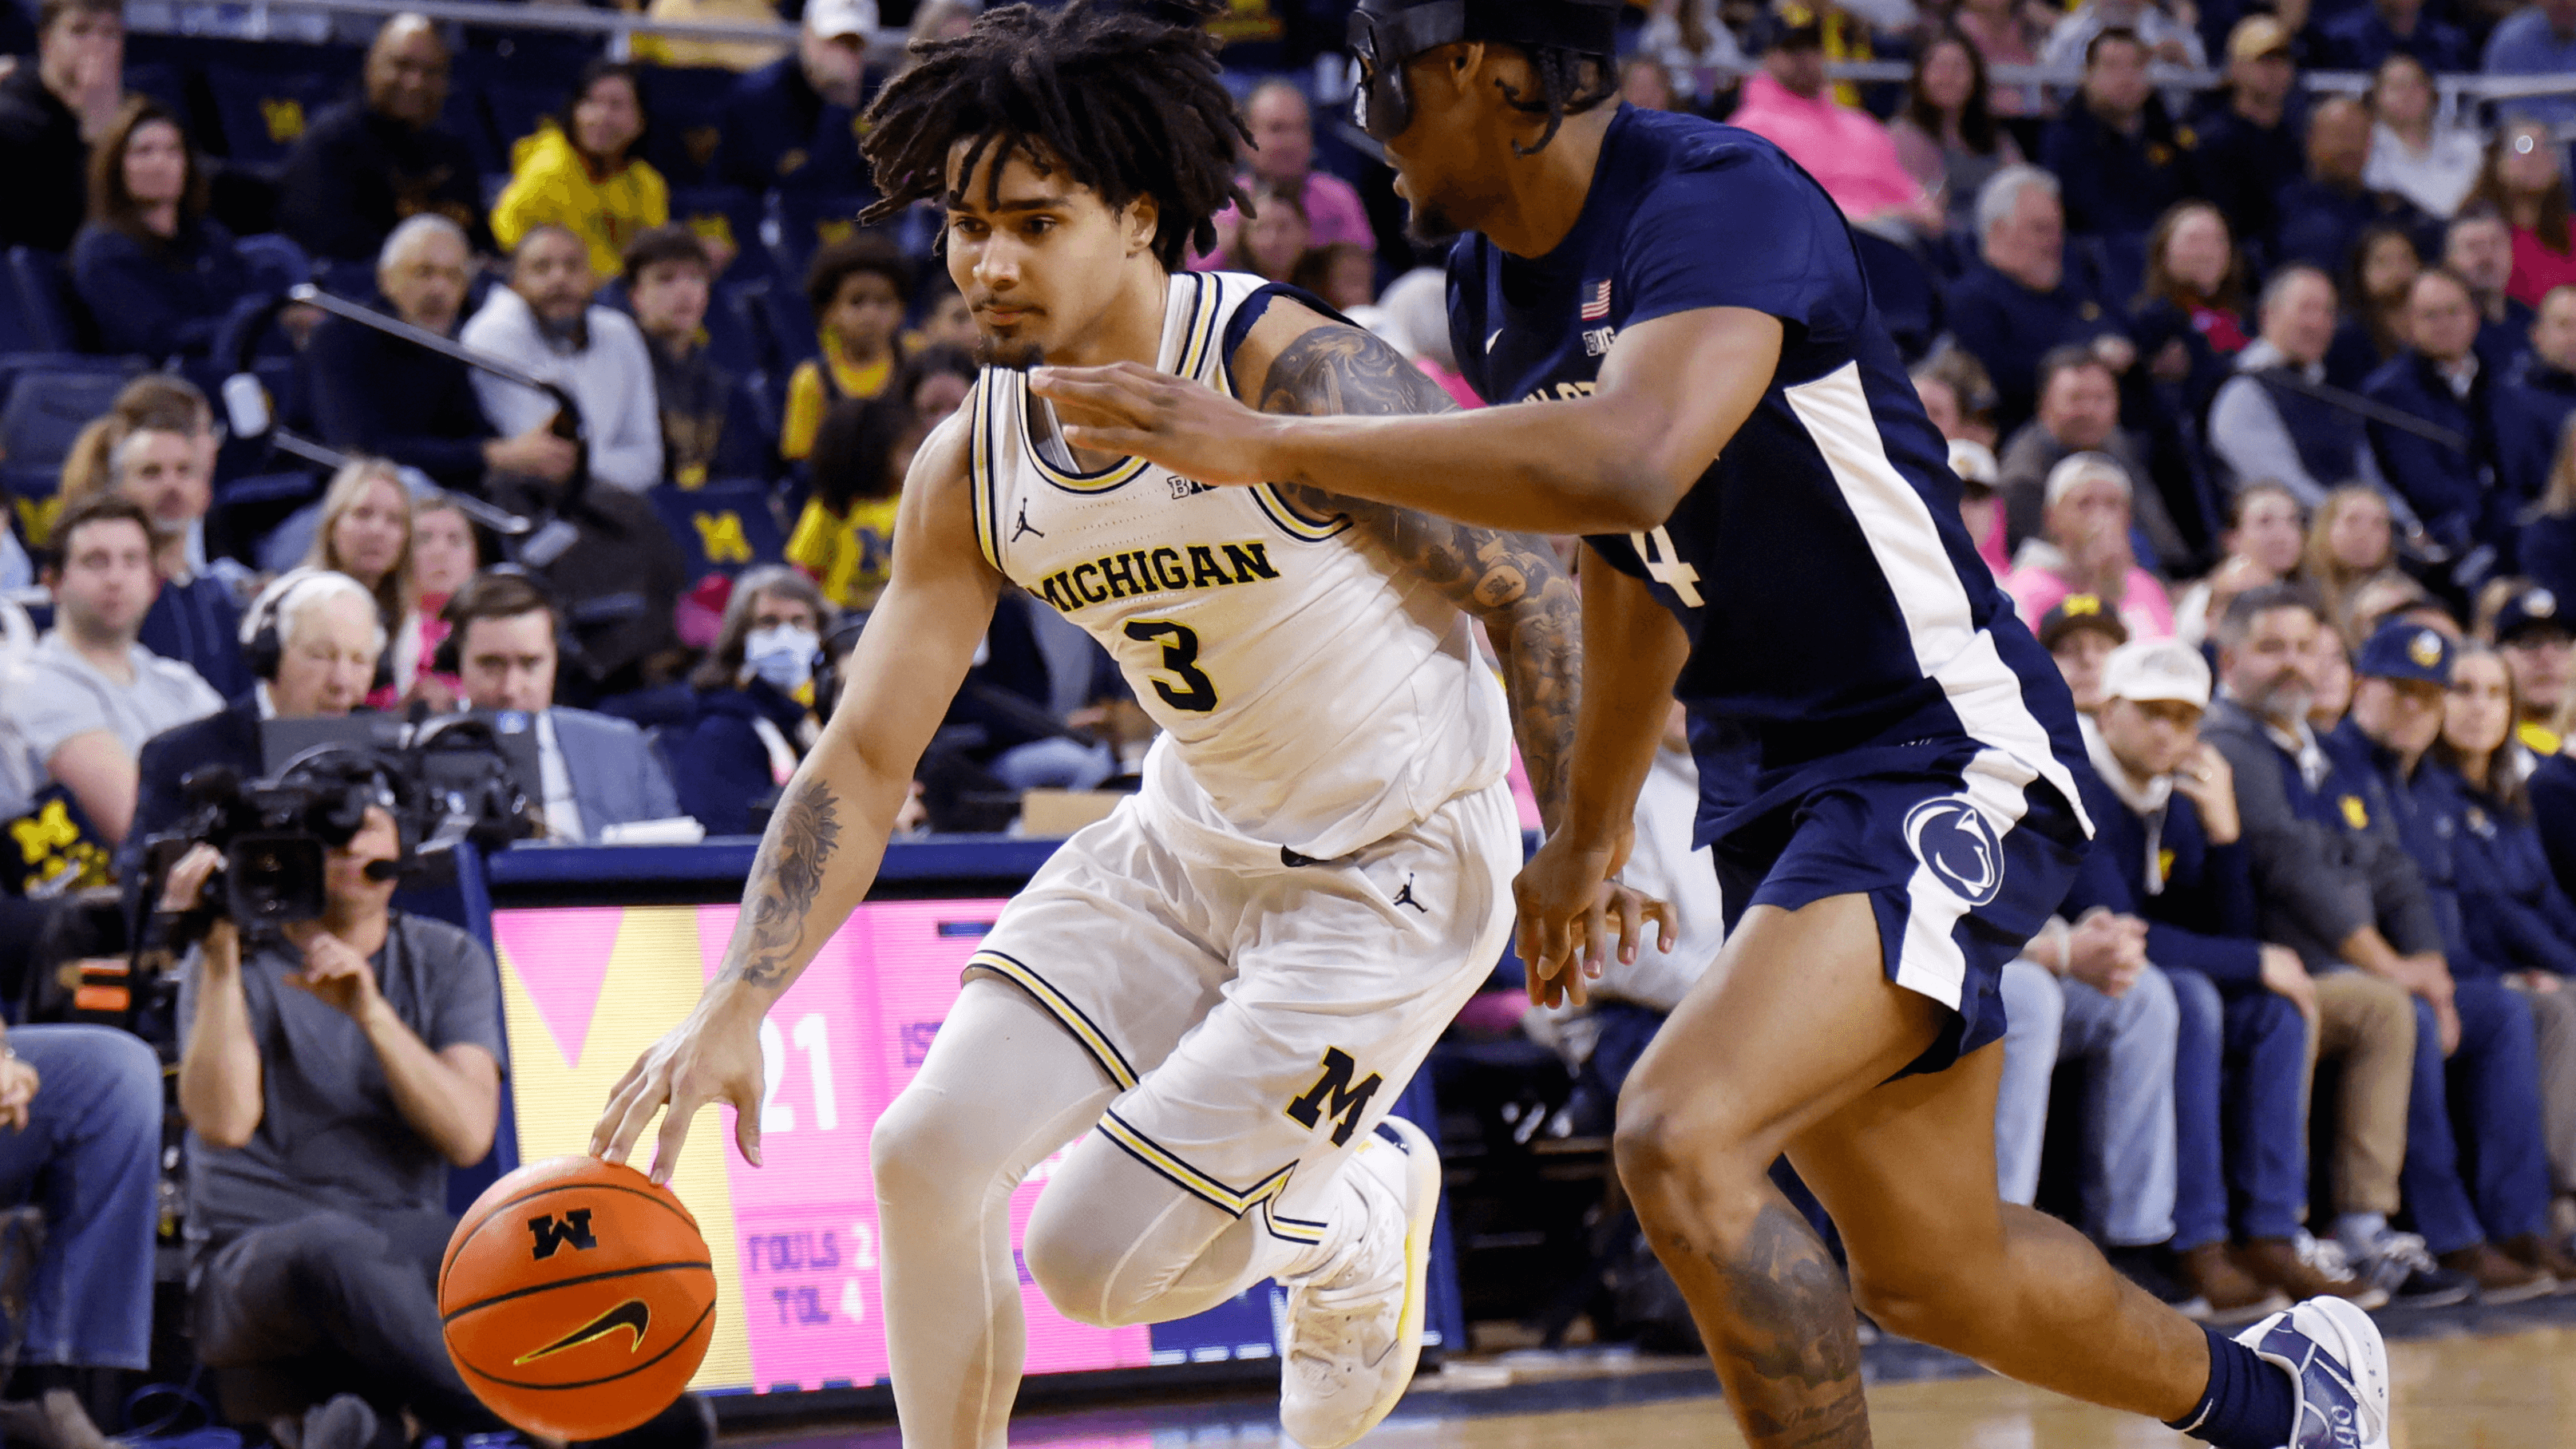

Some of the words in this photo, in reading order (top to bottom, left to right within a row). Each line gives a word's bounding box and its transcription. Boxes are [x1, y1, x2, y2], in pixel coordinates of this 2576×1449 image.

[1166, 475, 1220, 500] BI
[1122, 618, 1221, 713] 3
[759, 1013, 838, 1133] 21
[1284, 1045, 1383, 1148] M
[852, 1223, 875, 1269] 2
